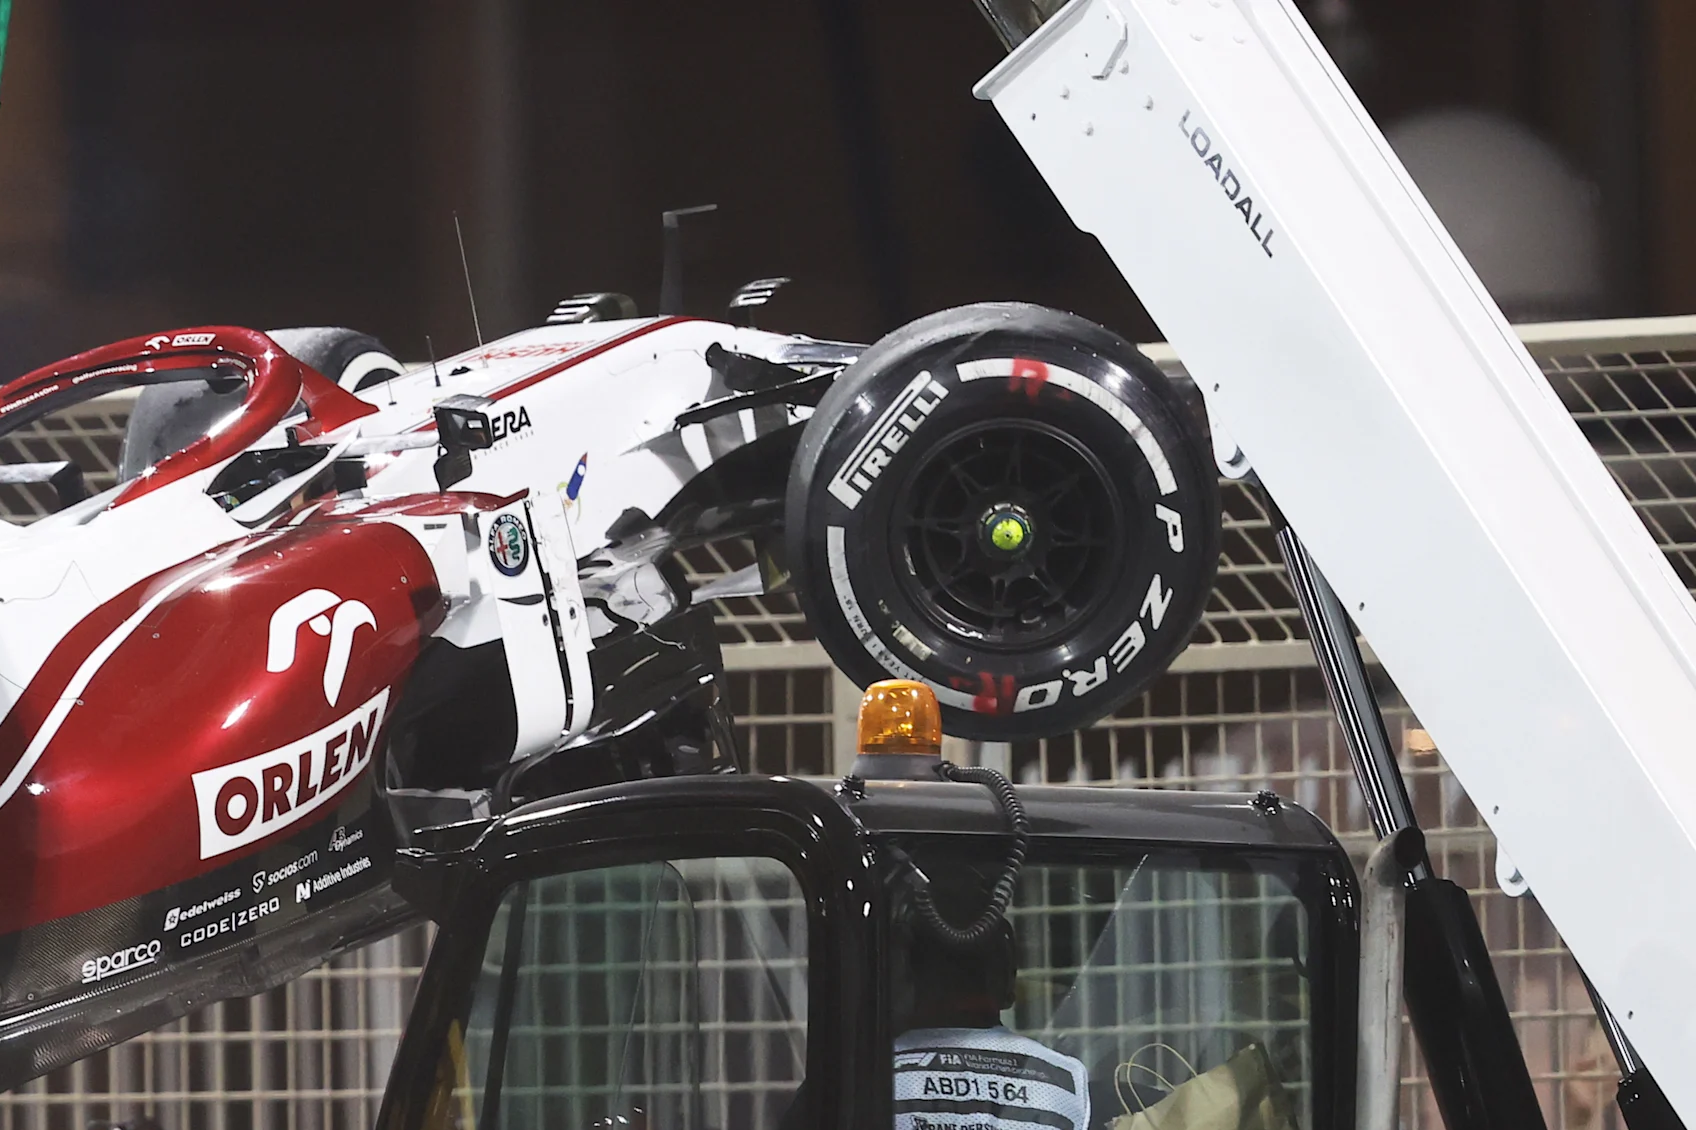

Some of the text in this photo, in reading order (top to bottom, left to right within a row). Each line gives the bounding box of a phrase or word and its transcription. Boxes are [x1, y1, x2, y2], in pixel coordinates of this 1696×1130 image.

[1179, 109, 1274, 258] LOADALL
[492, 406, 532, 443] ERA
[827, 370, 949, 510] PIRELLI
[1013, 503, 1184, 713] P ZERO
[215, 707, 378, 836] ORLEN
[313, 869, 340, 893] Additive
[340, 856, 371, 883] Industries
[179, 887, 242, 921] edelweiss
[81, 939, 161, 983] sparco
[939, 1053, 962, 1066] FIA
[923, 1077, 980, 1098] ABD1
